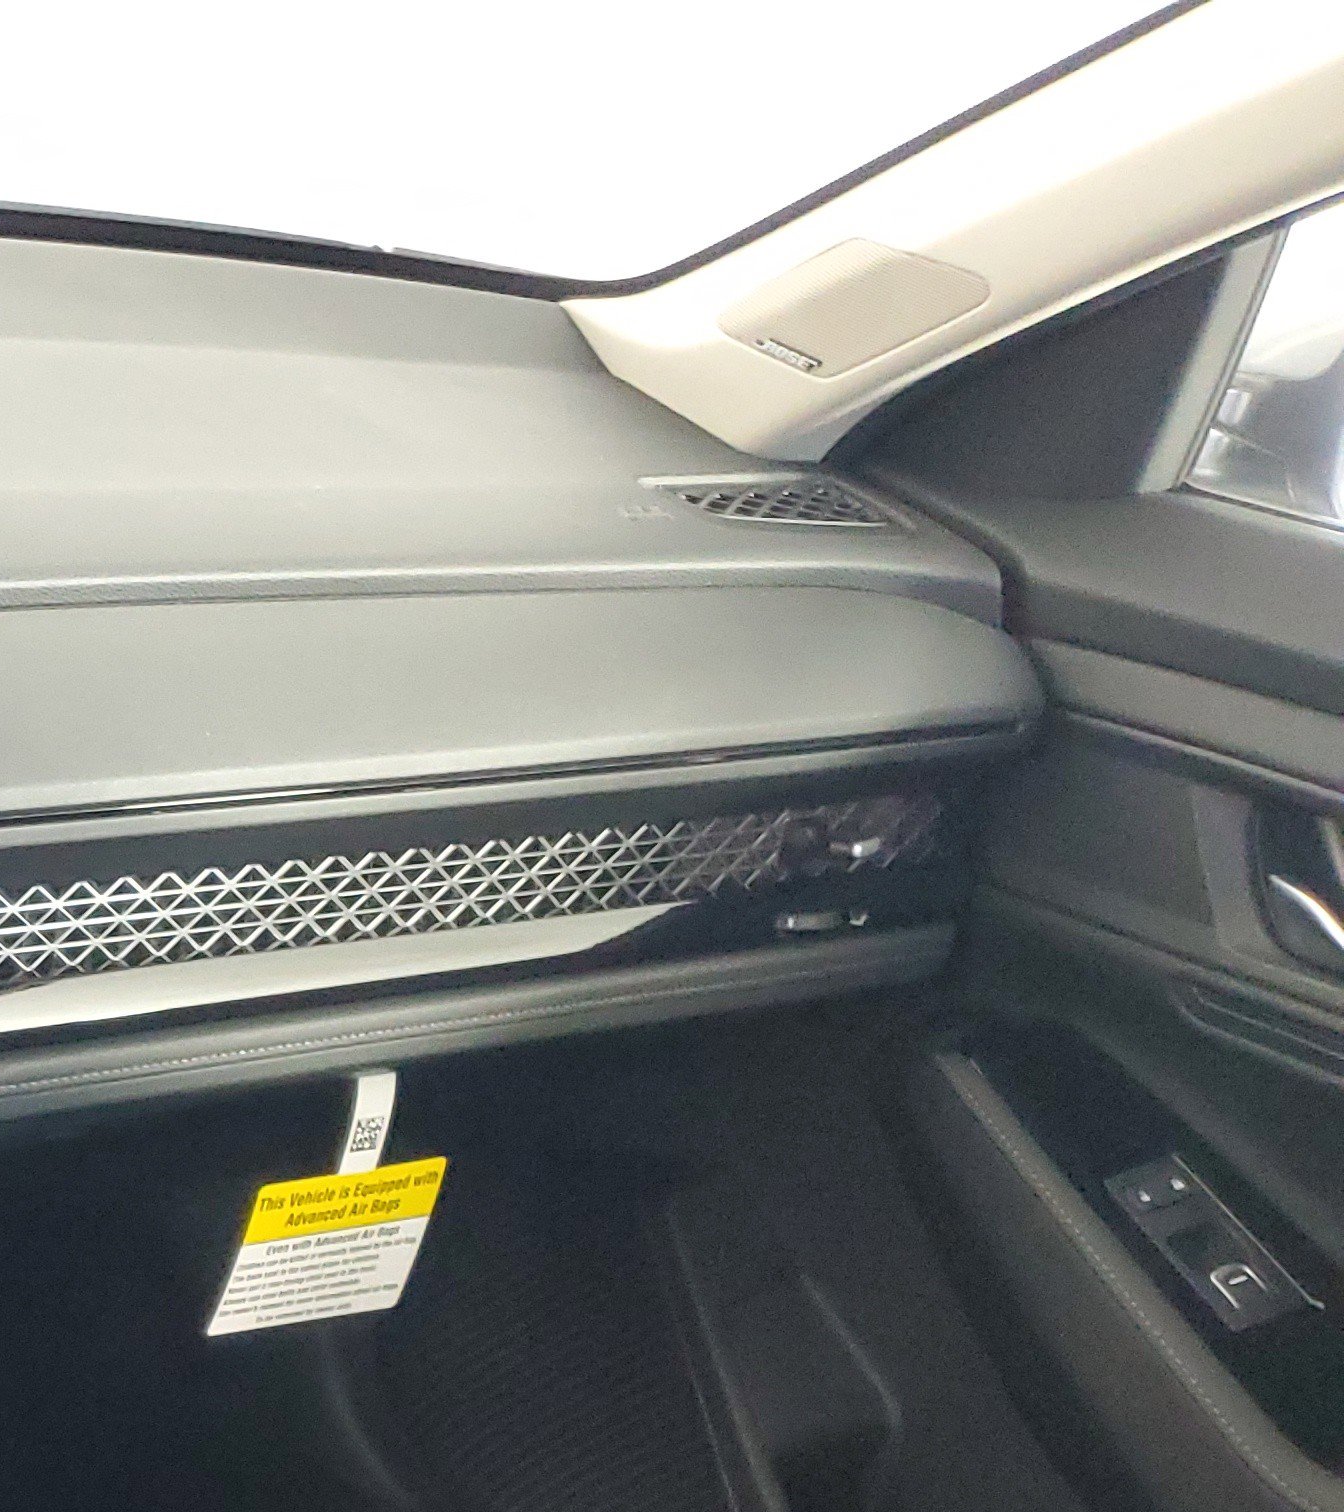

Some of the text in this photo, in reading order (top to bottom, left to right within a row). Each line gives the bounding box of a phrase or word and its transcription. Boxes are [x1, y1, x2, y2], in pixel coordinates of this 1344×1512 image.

[259, 1170, 440, 1212] This Vehicle is Equipped with
[284, 1198, 401, 1228] Advanced Air Bags
